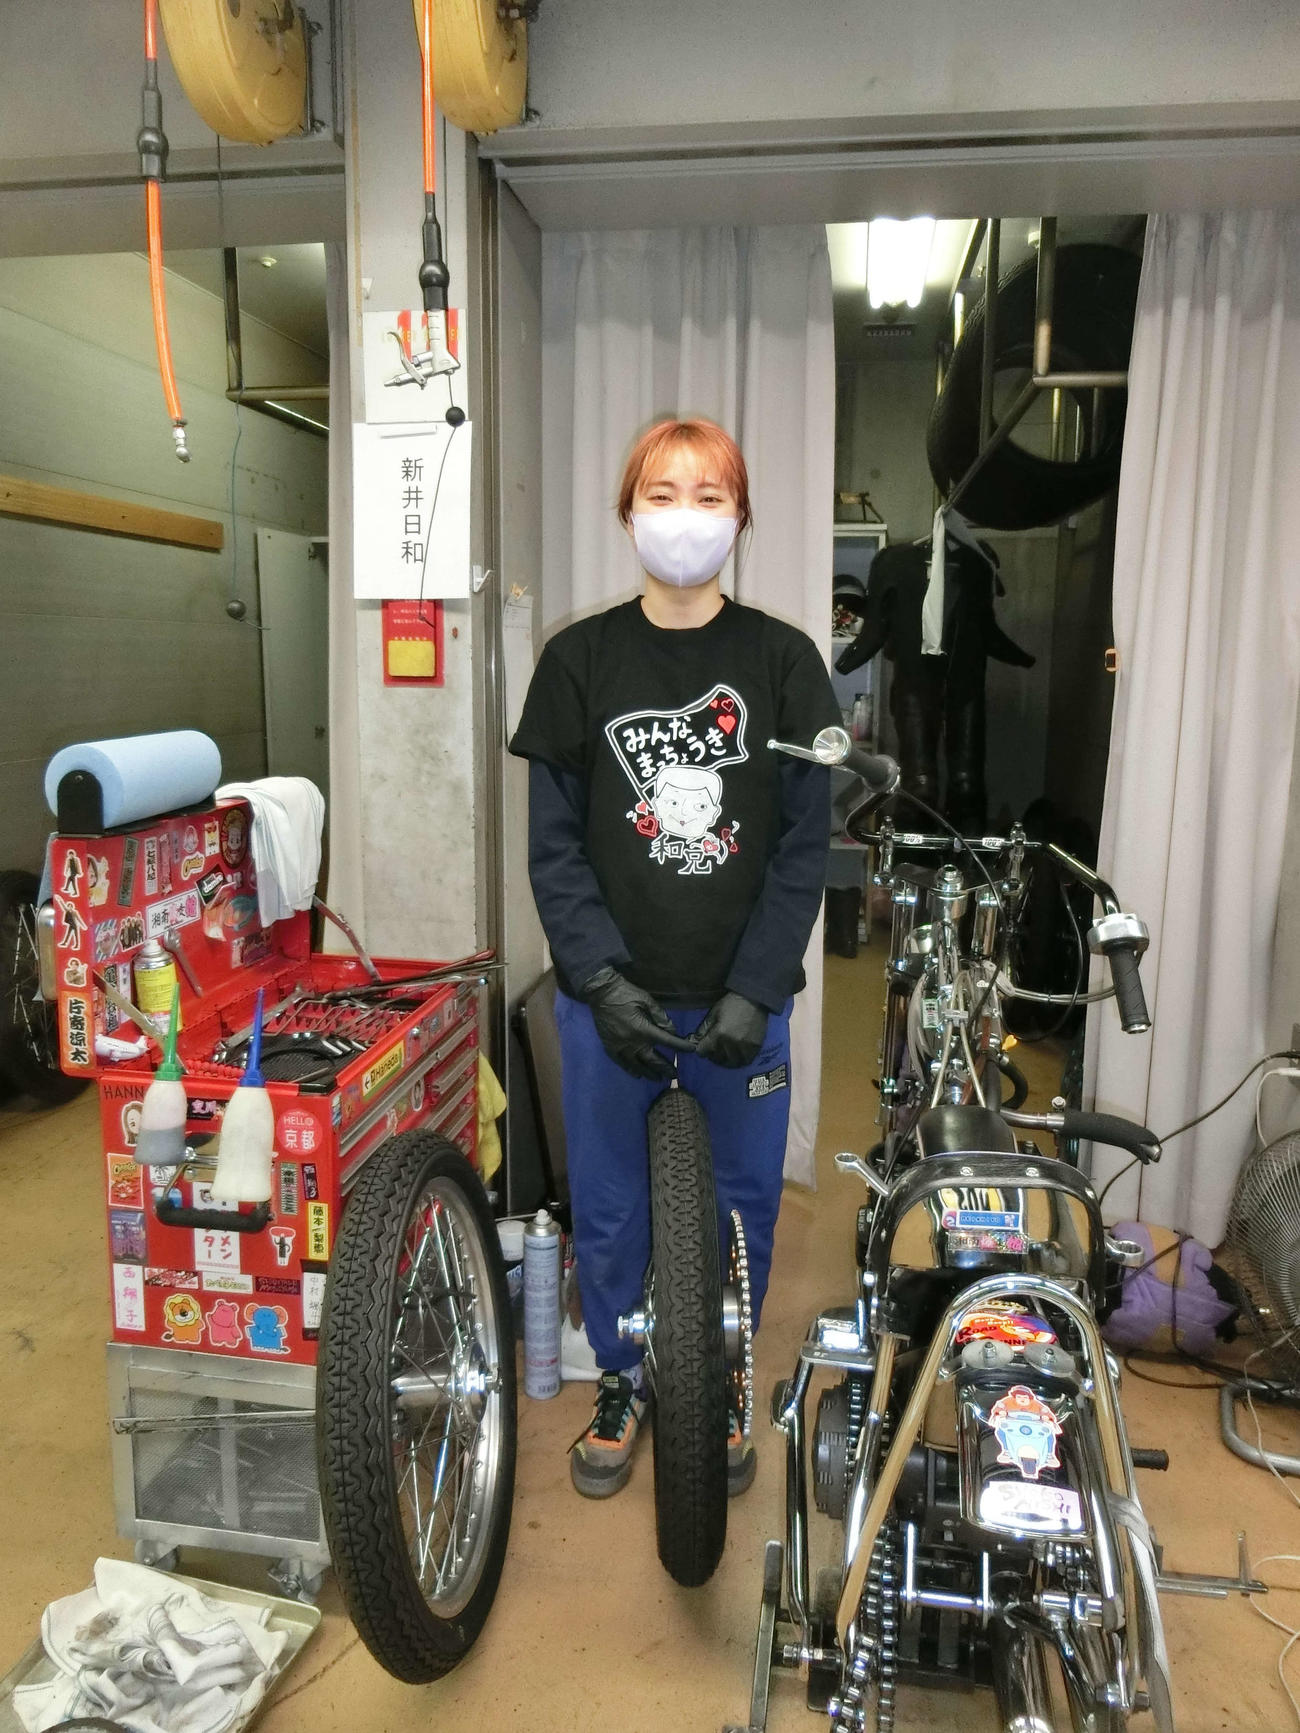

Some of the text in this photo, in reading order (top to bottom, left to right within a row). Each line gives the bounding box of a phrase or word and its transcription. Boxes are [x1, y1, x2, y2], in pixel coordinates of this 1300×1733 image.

[401, 457, 424, 565] 新井日和
[622, 716, 693, 753] みんな
[284, 1129, 316, 1150] 京都
